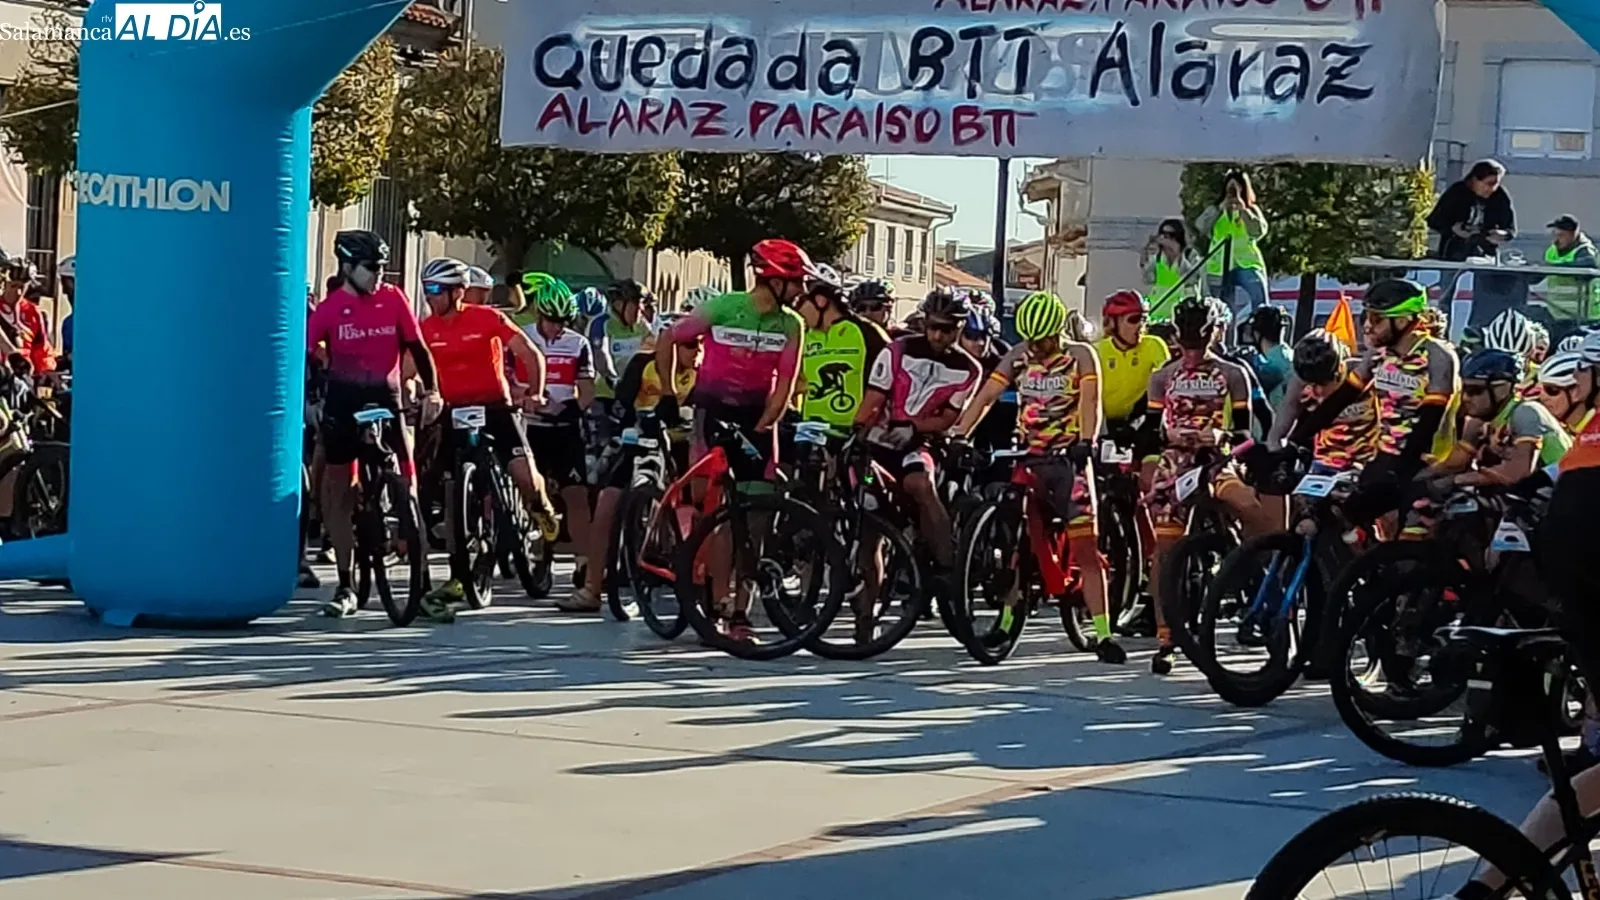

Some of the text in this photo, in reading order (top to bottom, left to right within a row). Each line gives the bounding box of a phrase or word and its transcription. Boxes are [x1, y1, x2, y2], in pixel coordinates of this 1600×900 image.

[533, 20, 1375, 106] Quedada BTT Alaraz
[77, 171, 231, 212] ECATHLON
